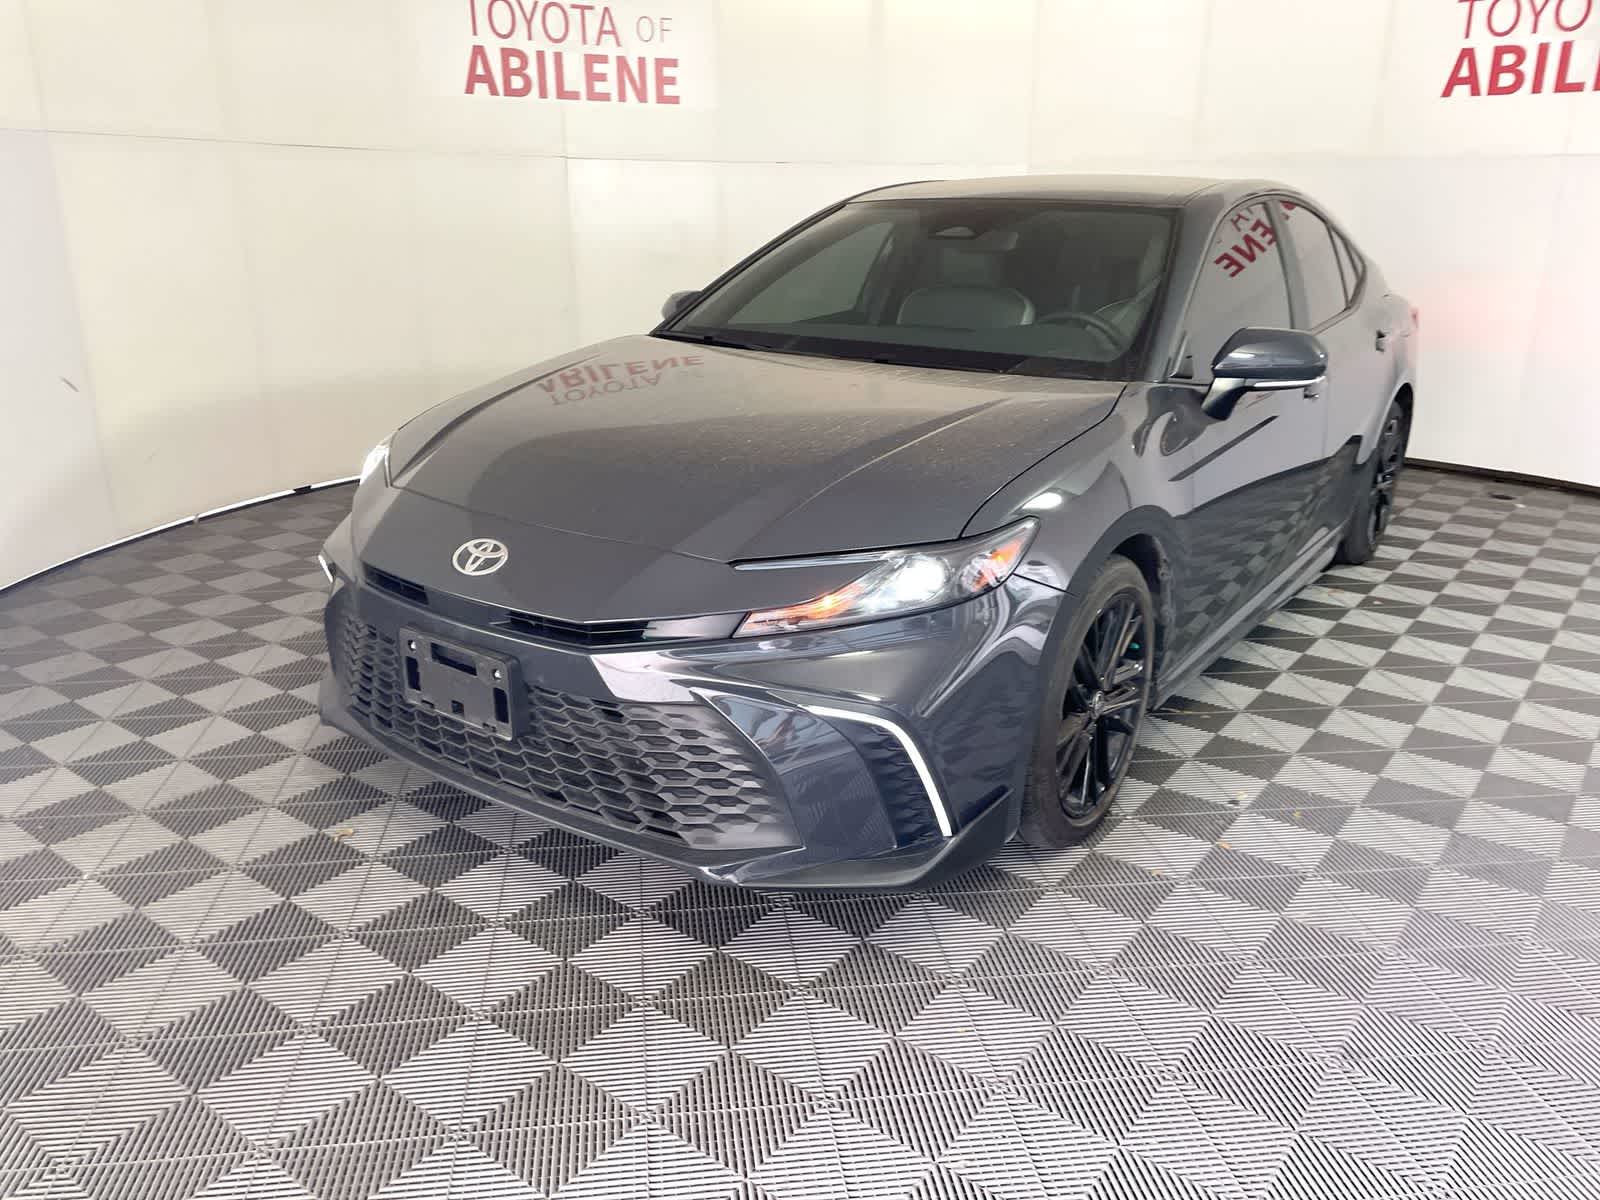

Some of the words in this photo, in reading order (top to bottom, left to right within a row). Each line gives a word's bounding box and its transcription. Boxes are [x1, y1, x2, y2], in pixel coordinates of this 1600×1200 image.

[468, 0, 622, 47] TOYOTA
[636, 15, 673, 43] OF
[464, 44, 681, 105] ABILENE
[1440, 40, 1600, 98] ABIL
